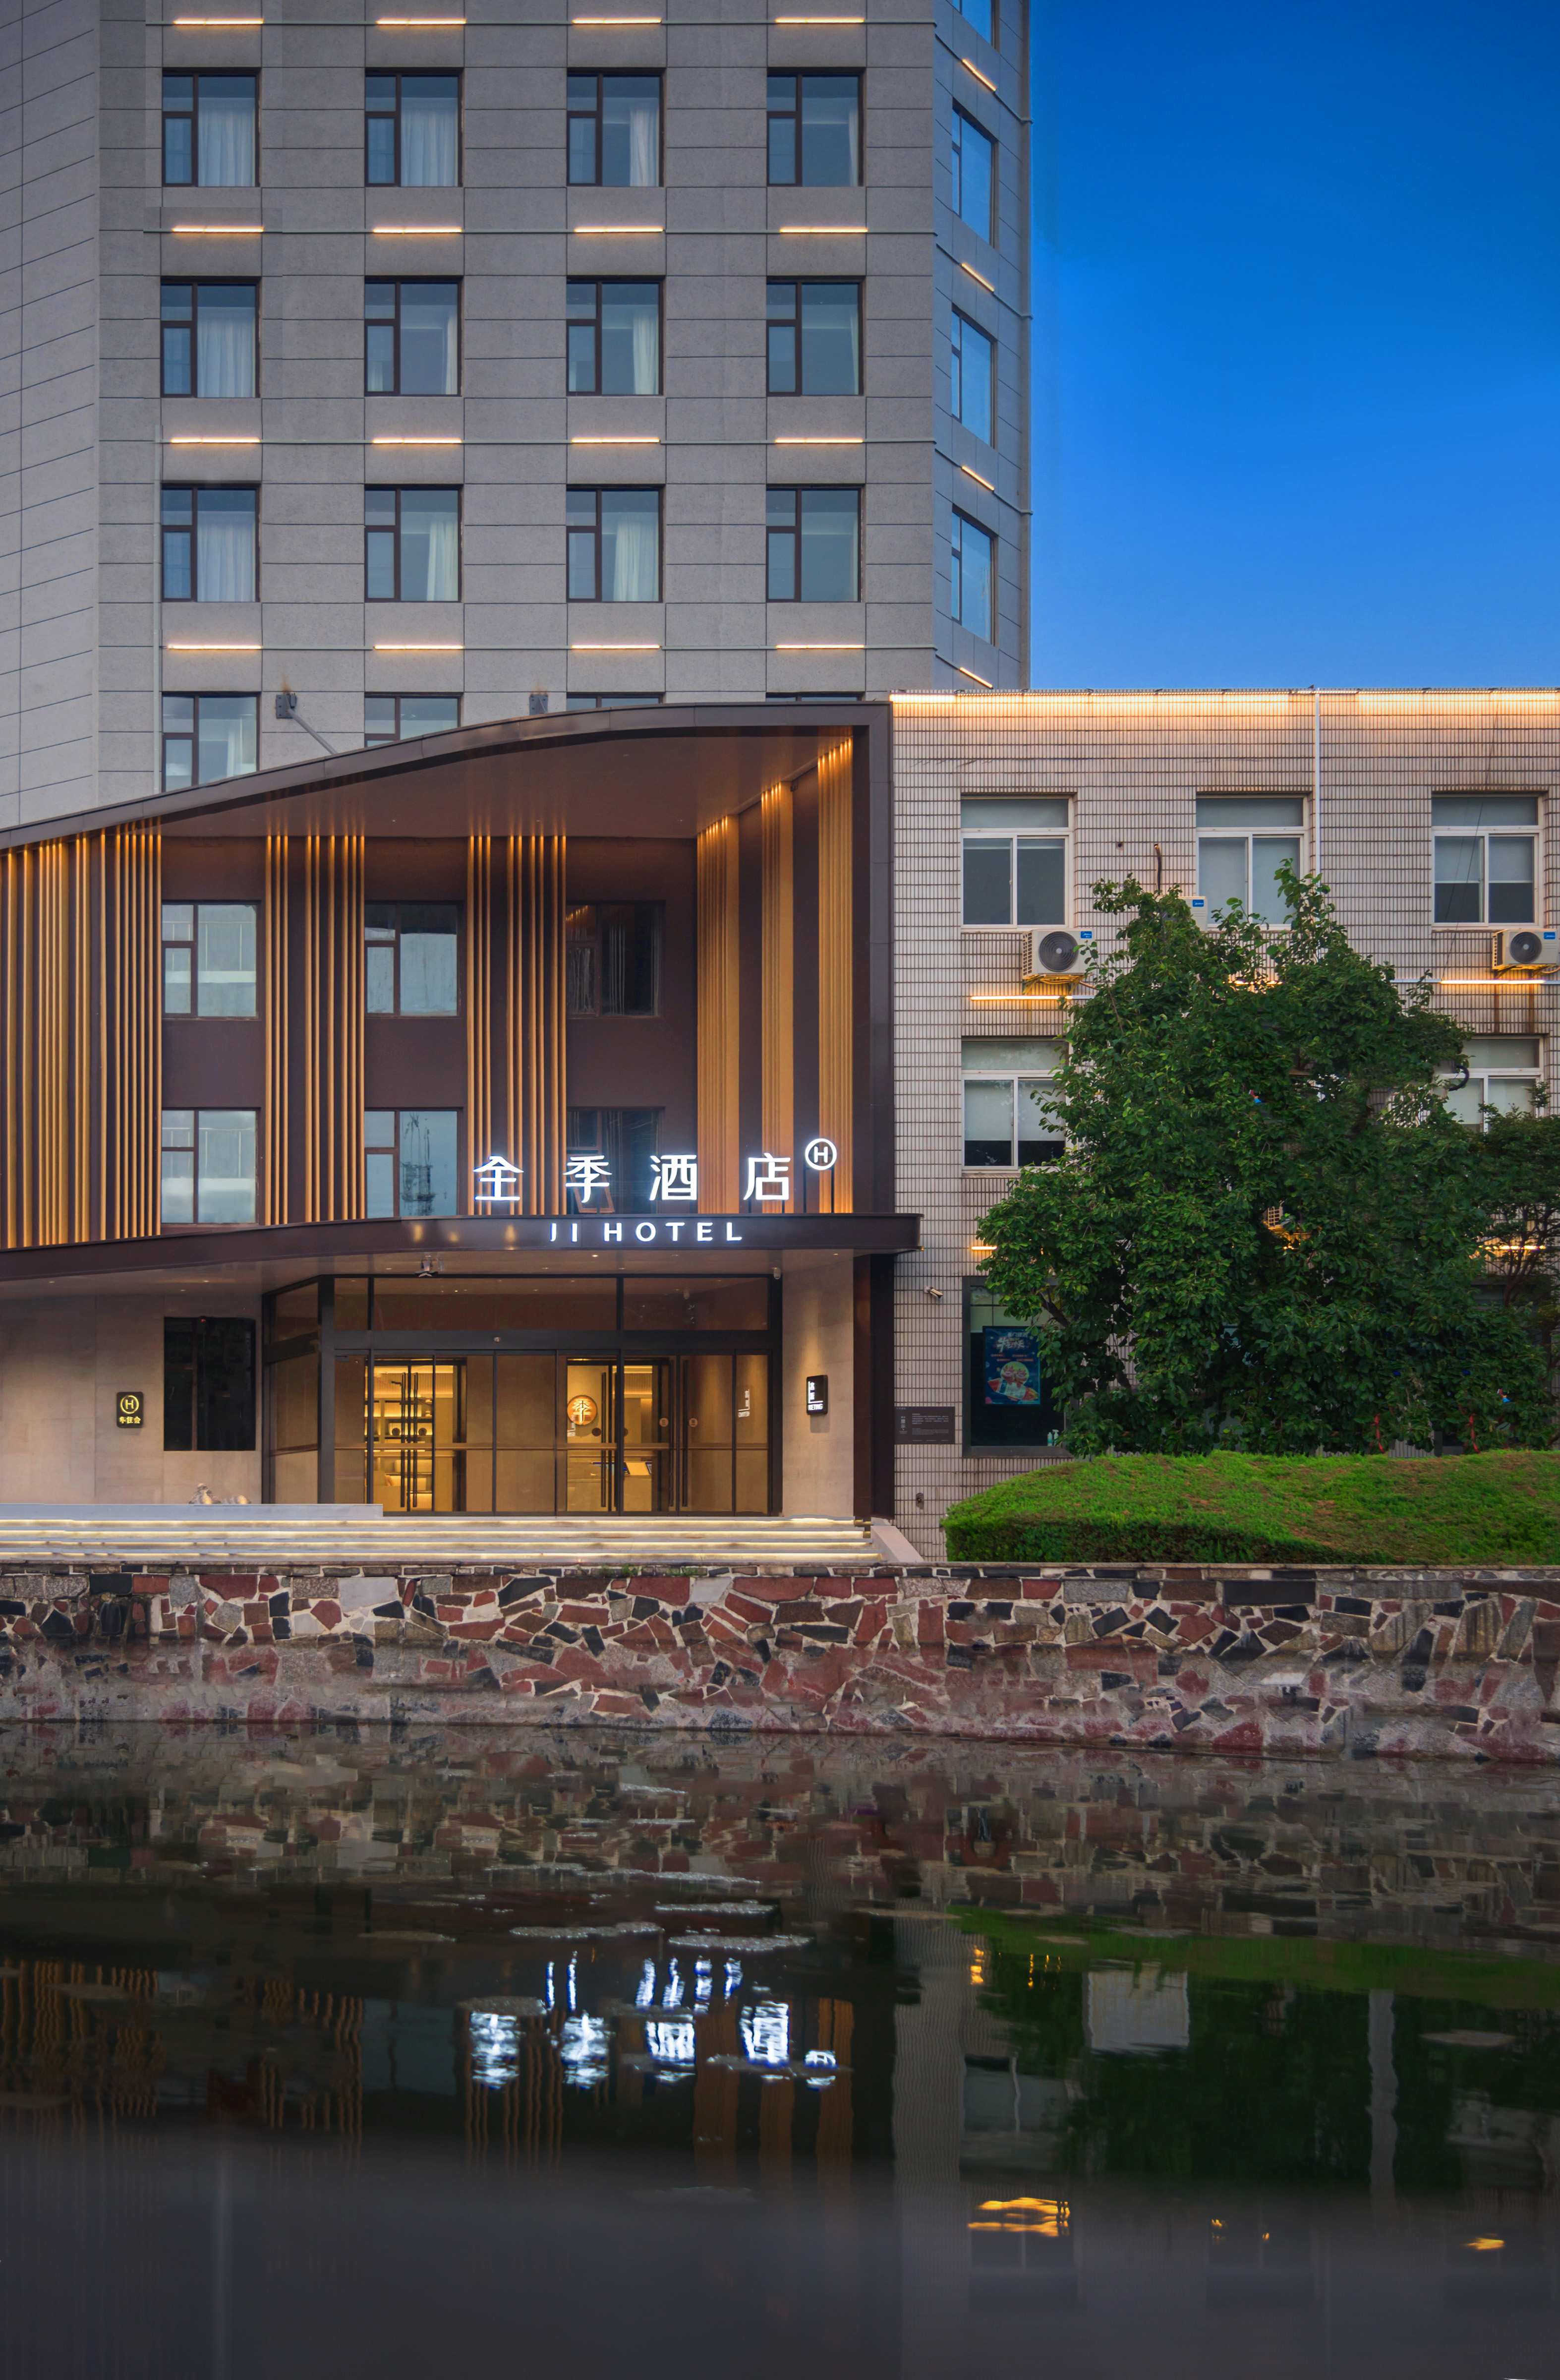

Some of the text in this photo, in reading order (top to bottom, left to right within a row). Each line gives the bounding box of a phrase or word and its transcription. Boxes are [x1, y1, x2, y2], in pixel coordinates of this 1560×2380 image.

[472, 1152, 791, 1203] 全季酒店
[550, 1222, 743, 1242] JI HOTEL
